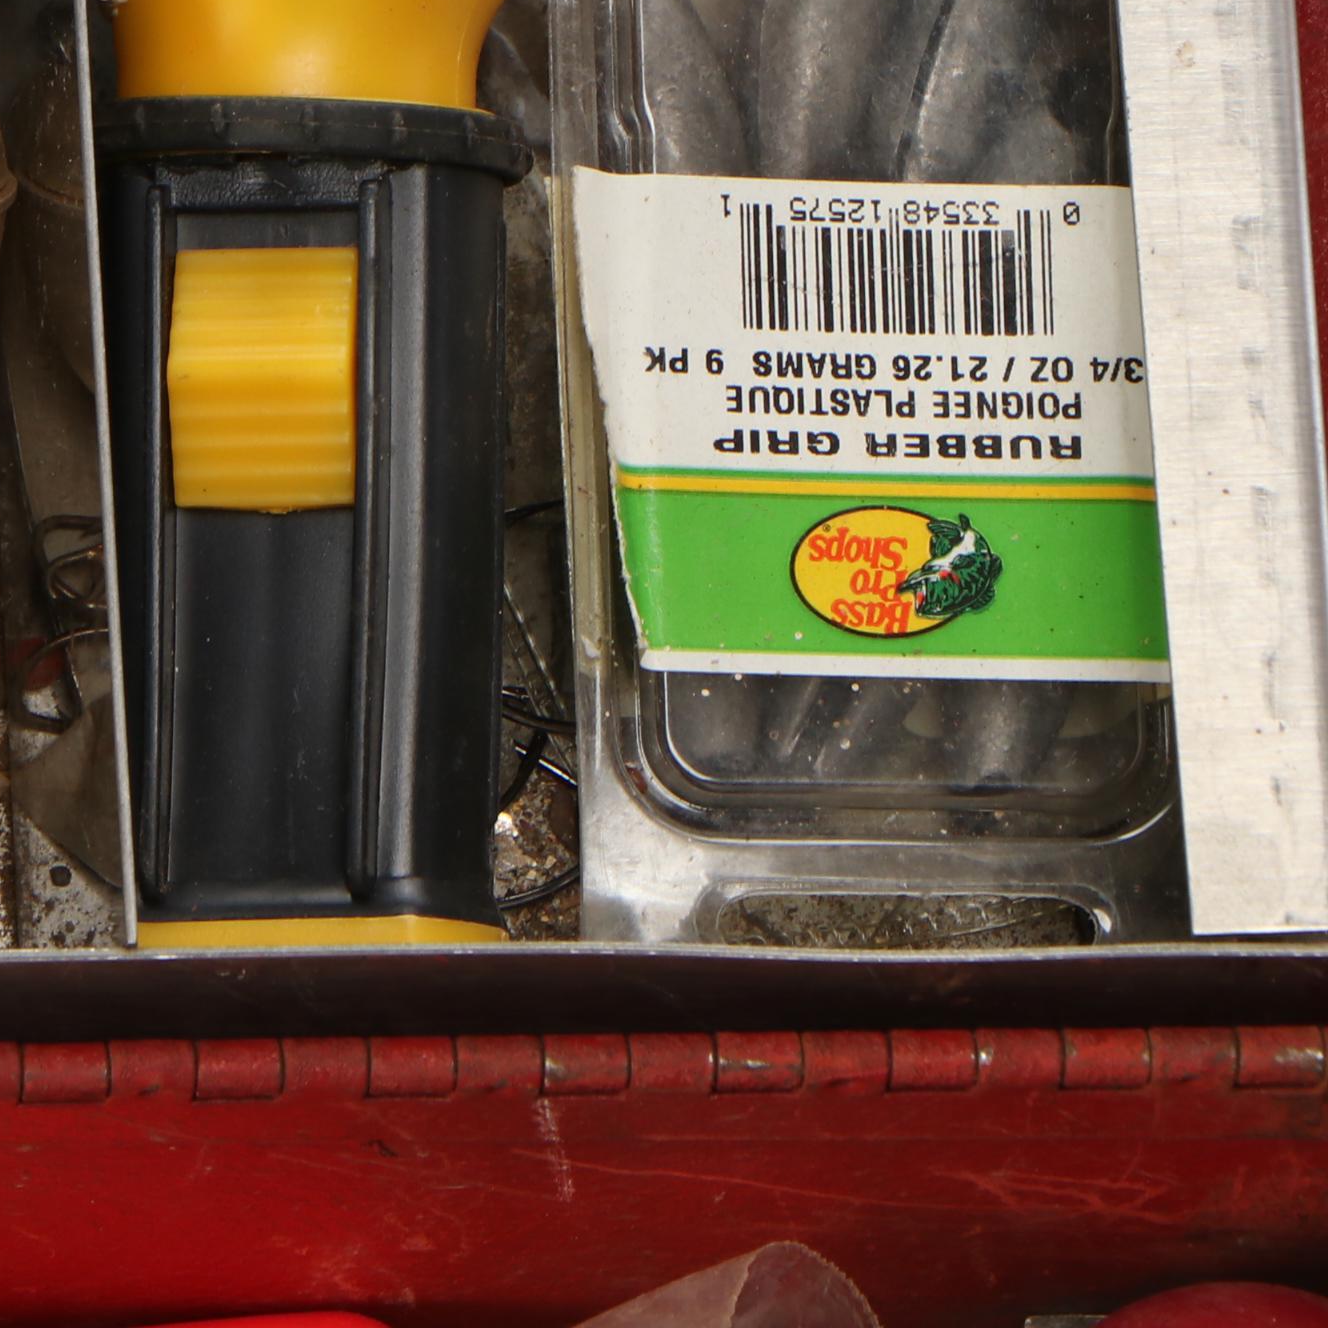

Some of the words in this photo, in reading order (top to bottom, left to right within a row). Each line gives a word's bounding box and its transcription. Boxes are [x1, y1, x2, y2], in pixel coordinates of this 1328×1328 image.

[720, 194, 732, 217] 1
[789, 198, 883, 224] 12575
[903, 200, 1000, 225] 33548
[1063, 201, 1081, 225] 0
[644, 347, 688, 372] PK
[706, 349, 725, 375] 9
[752, 351, 877, 379] GRAMS
[892, 354, 987, 382] 21.26
[1003, 355, 1014, 381] /
[1030, 356, 1074, 382] OZ
[1089, 357, 1144, 384] 3/4
[724, 386, 916, 418] PLASTIQUE
[932, 390, 1081, 418] POIGNEE
[712, 430, 841, 456] GRIP
[863, 432, 1082, 460] RUBBER
[807, 527, 908, 572] Shops
[849, 569, 905, 603] Pro
[830, 597, 914, 635] Bass
